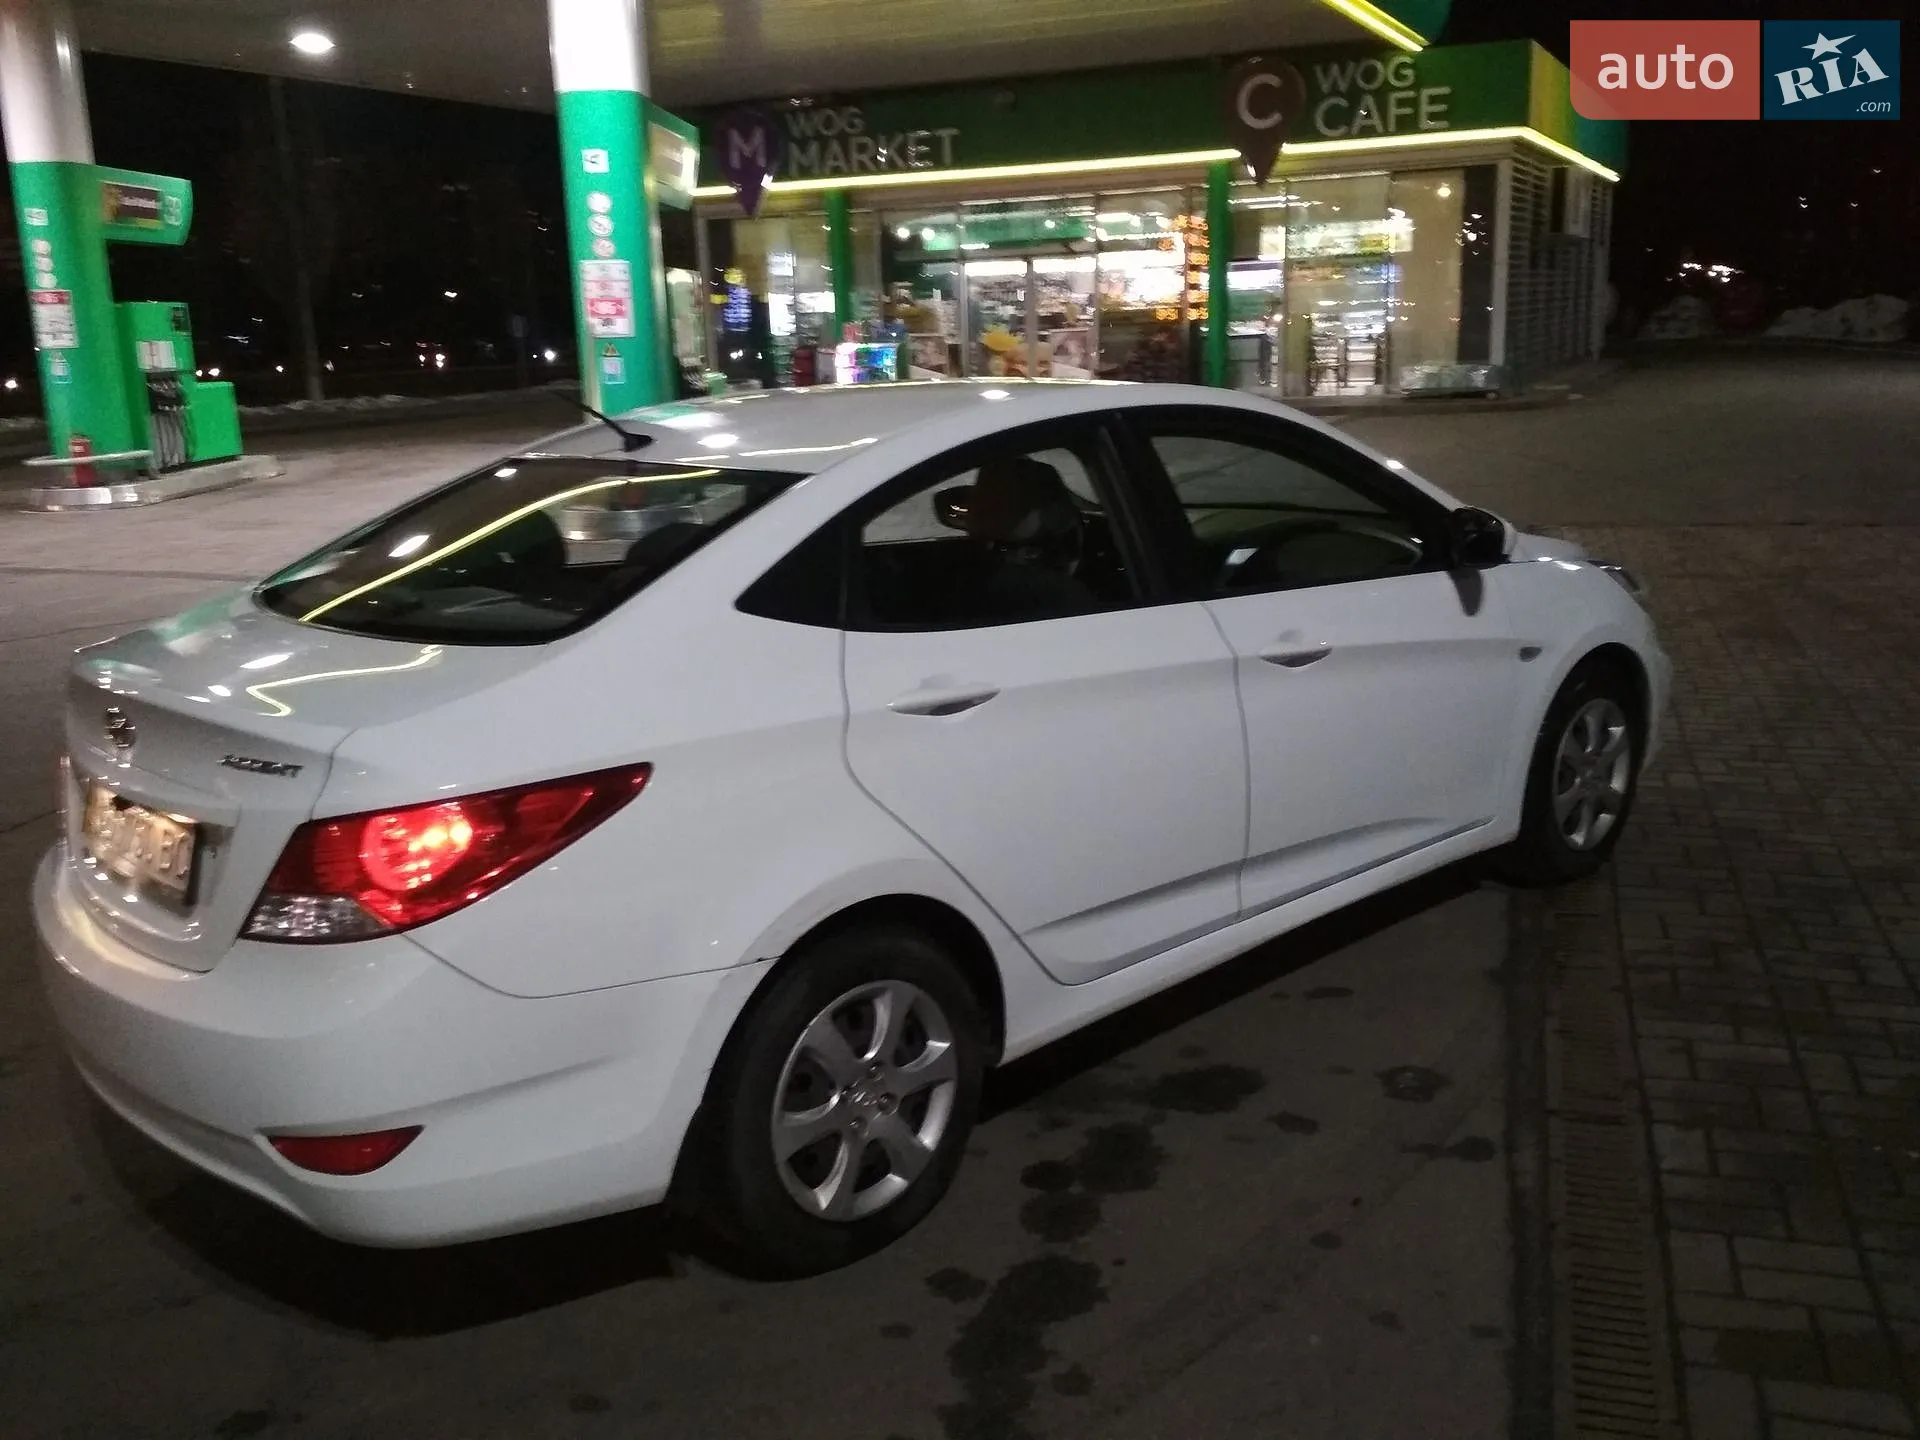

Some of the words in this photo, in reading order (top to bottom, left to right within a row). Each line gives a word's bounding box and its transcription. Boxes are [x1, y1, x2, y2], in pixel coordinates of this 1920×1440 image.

[1313, 56, 1415, 93] WOG
[785, 107, 866, 139] WOG
[1237, 73, 1283, 130] C
[1314, 86, 1452, 138] CAFE
[727, 127, 768, 169] M
[787, 127, 960, 177] MARKET
